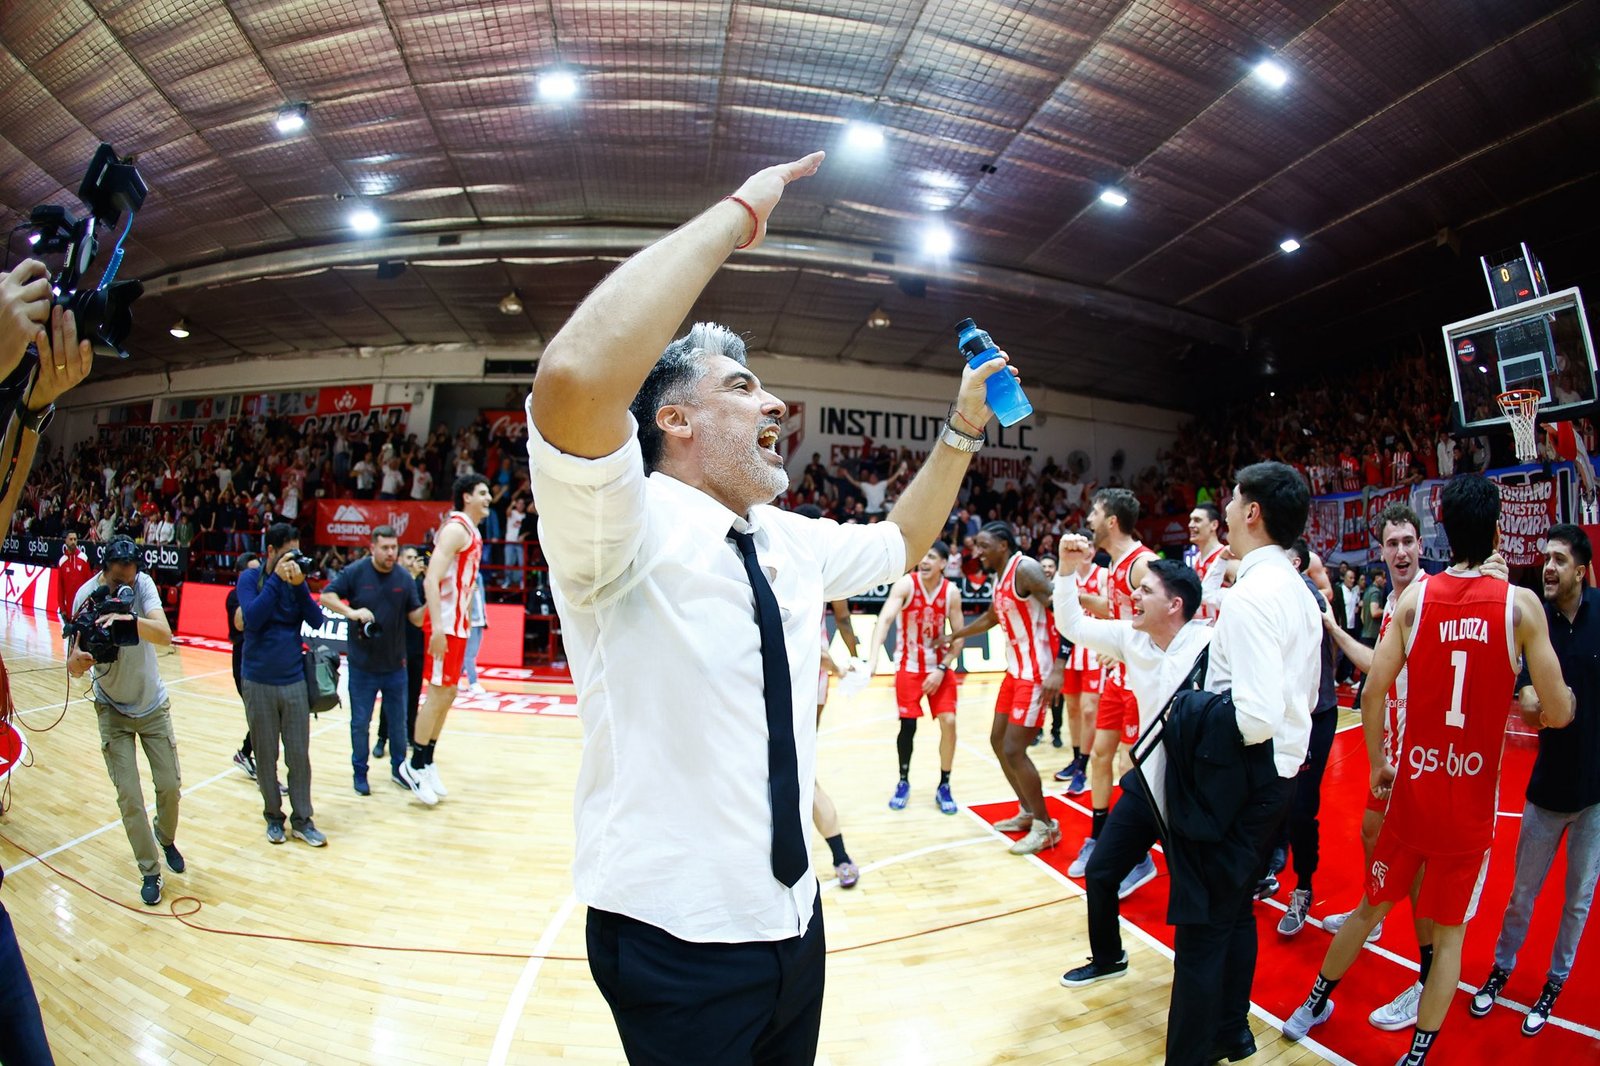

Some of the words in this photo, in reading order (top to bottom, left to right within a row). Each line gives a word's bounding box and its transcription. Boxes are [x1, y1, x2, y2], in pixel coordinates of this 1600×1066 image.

[1501, 268, 1510, 282] 0
[820, 407, 945, 441] INSTITUT
[326, 522, 371, 535] casinos
[1439, 617, 1489, 644] VILDOZA
[1445, 650, 1468, 730] 1
